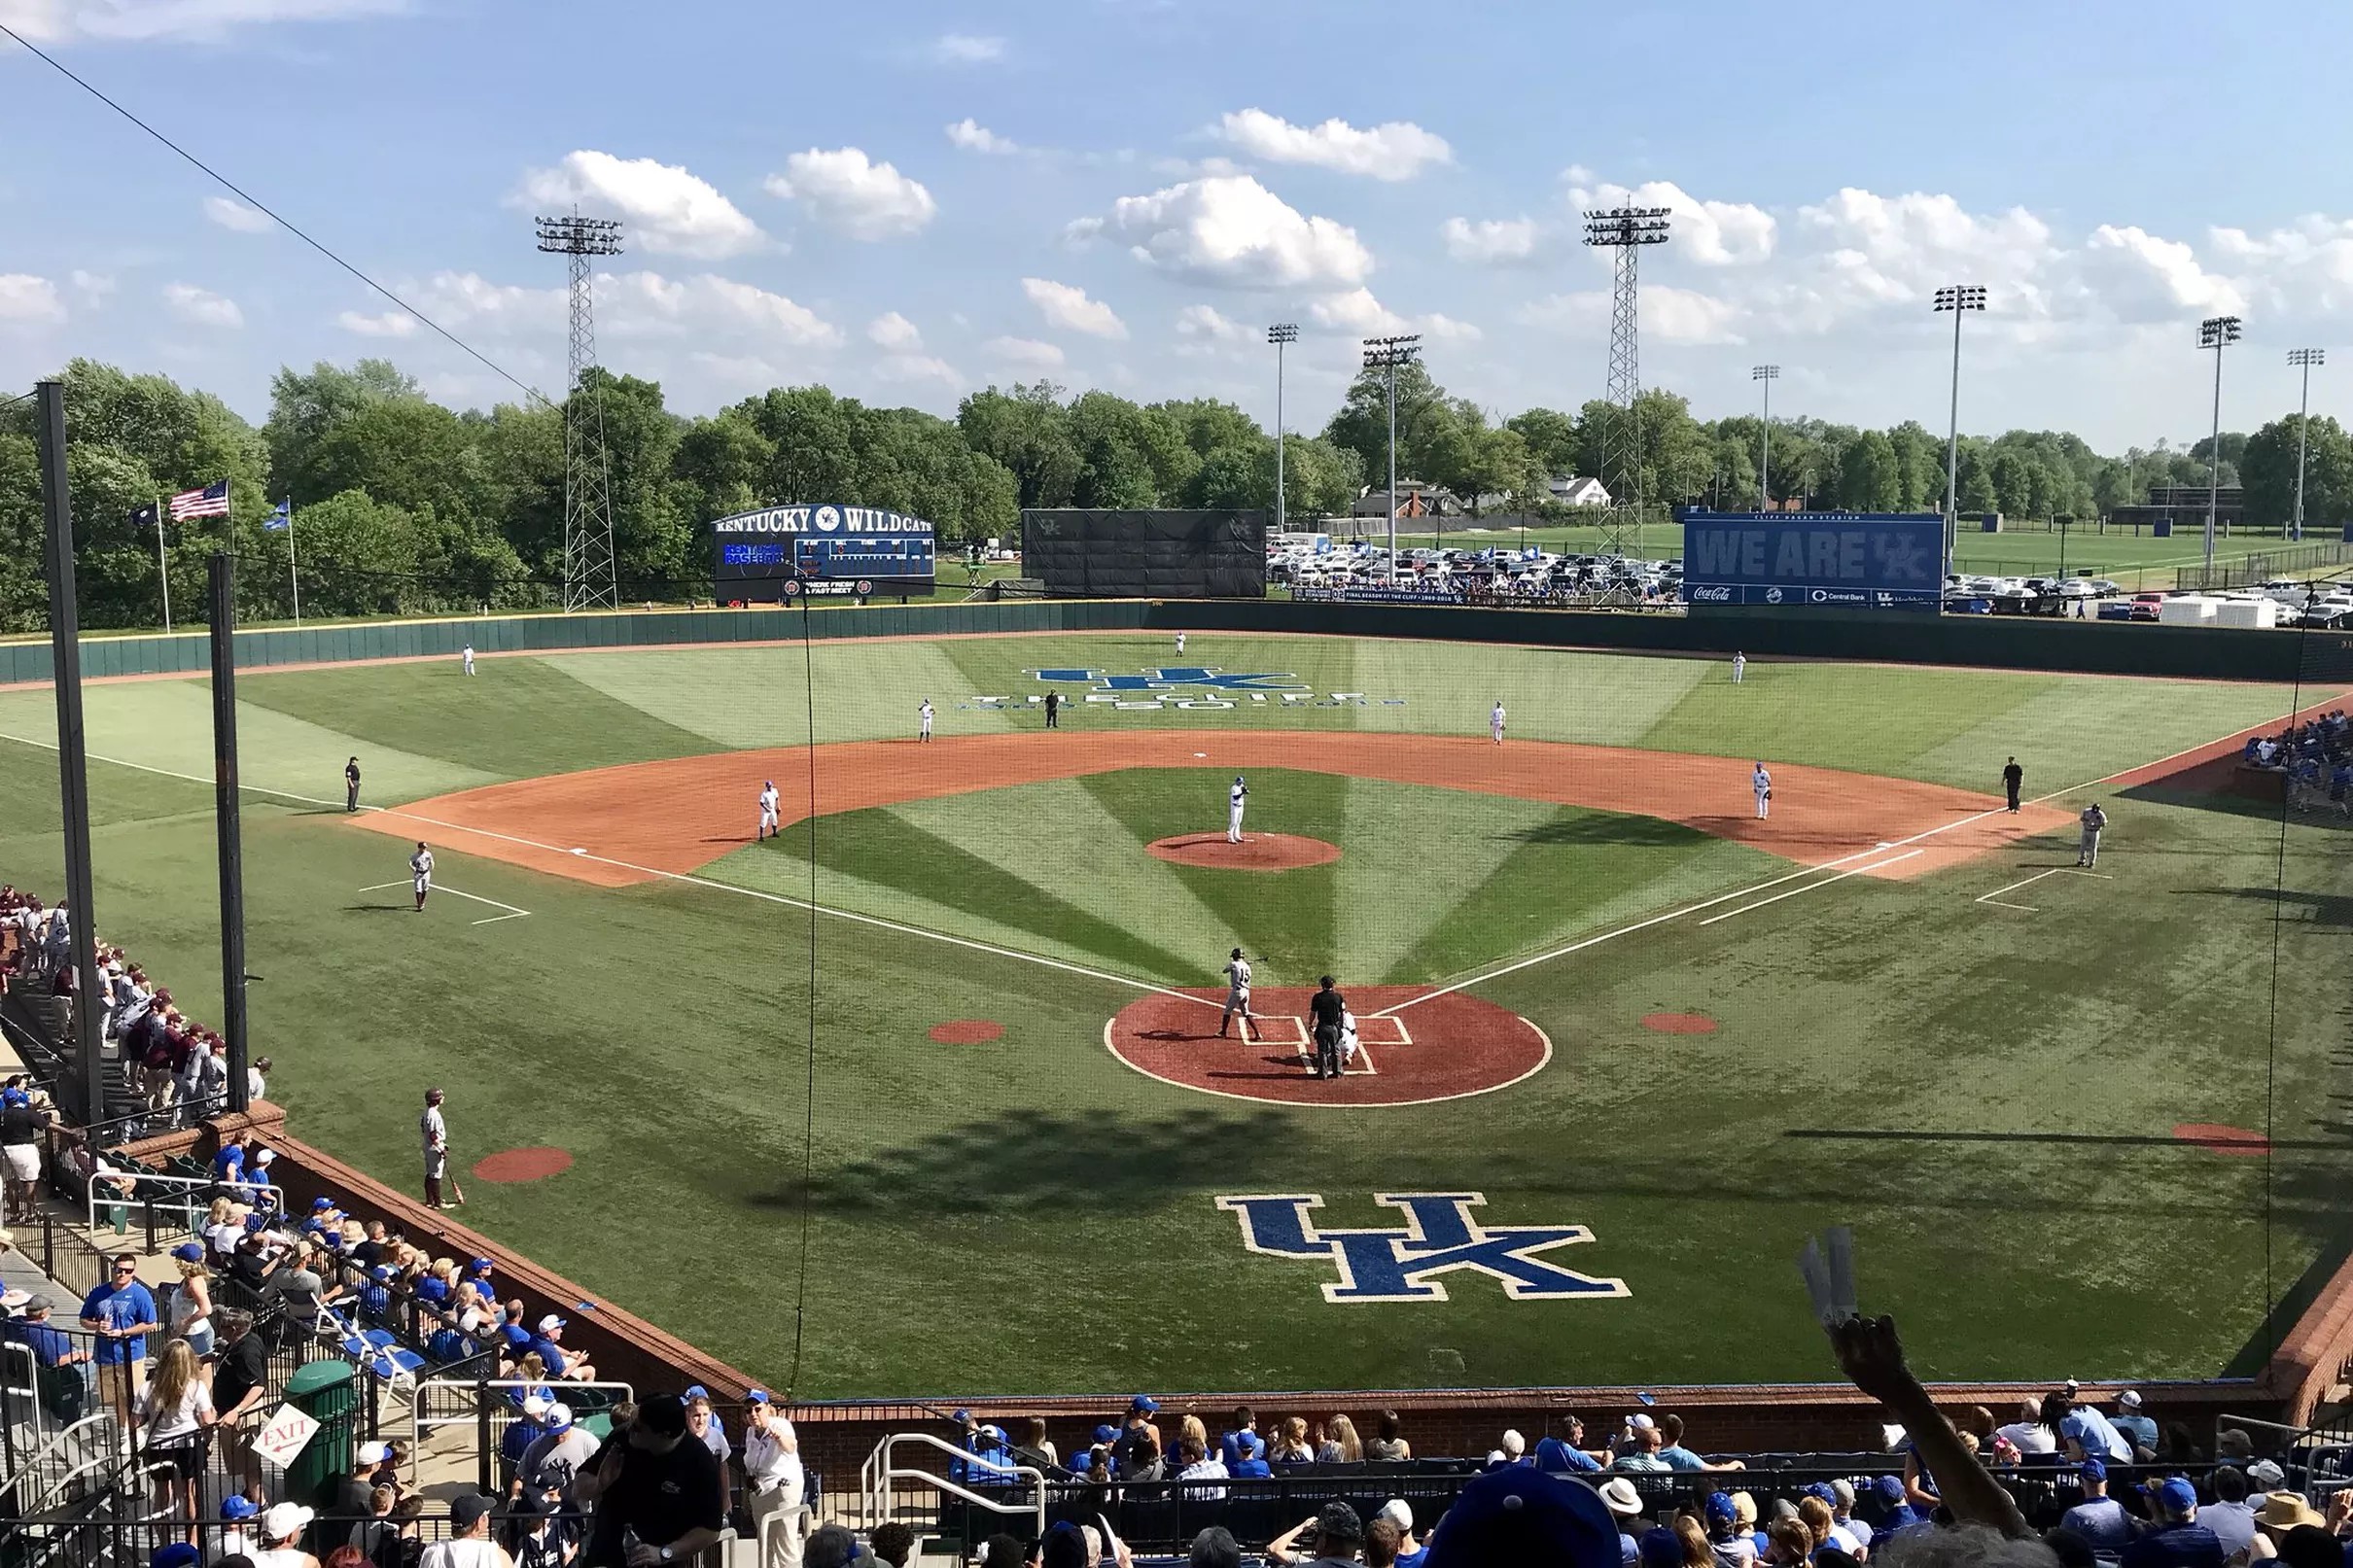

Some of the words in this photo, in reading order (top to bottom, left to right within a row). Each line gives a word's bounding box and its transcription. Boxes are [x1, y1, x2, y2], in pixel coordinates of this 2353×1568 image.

[717, 507, 811, 533] KENTUCKY
[843, 507, 932, 533] WILDCATS
[1696, 530, 1766, 576] WE
[1774, 531, 1866, 577] ARE
[1332, 589, 1345, 599] 02
[1240, 968, 1250, 983] 15
[1214, 1191, 1633, 1304] UK
[263, 1417, 308, 1446] EXIT
